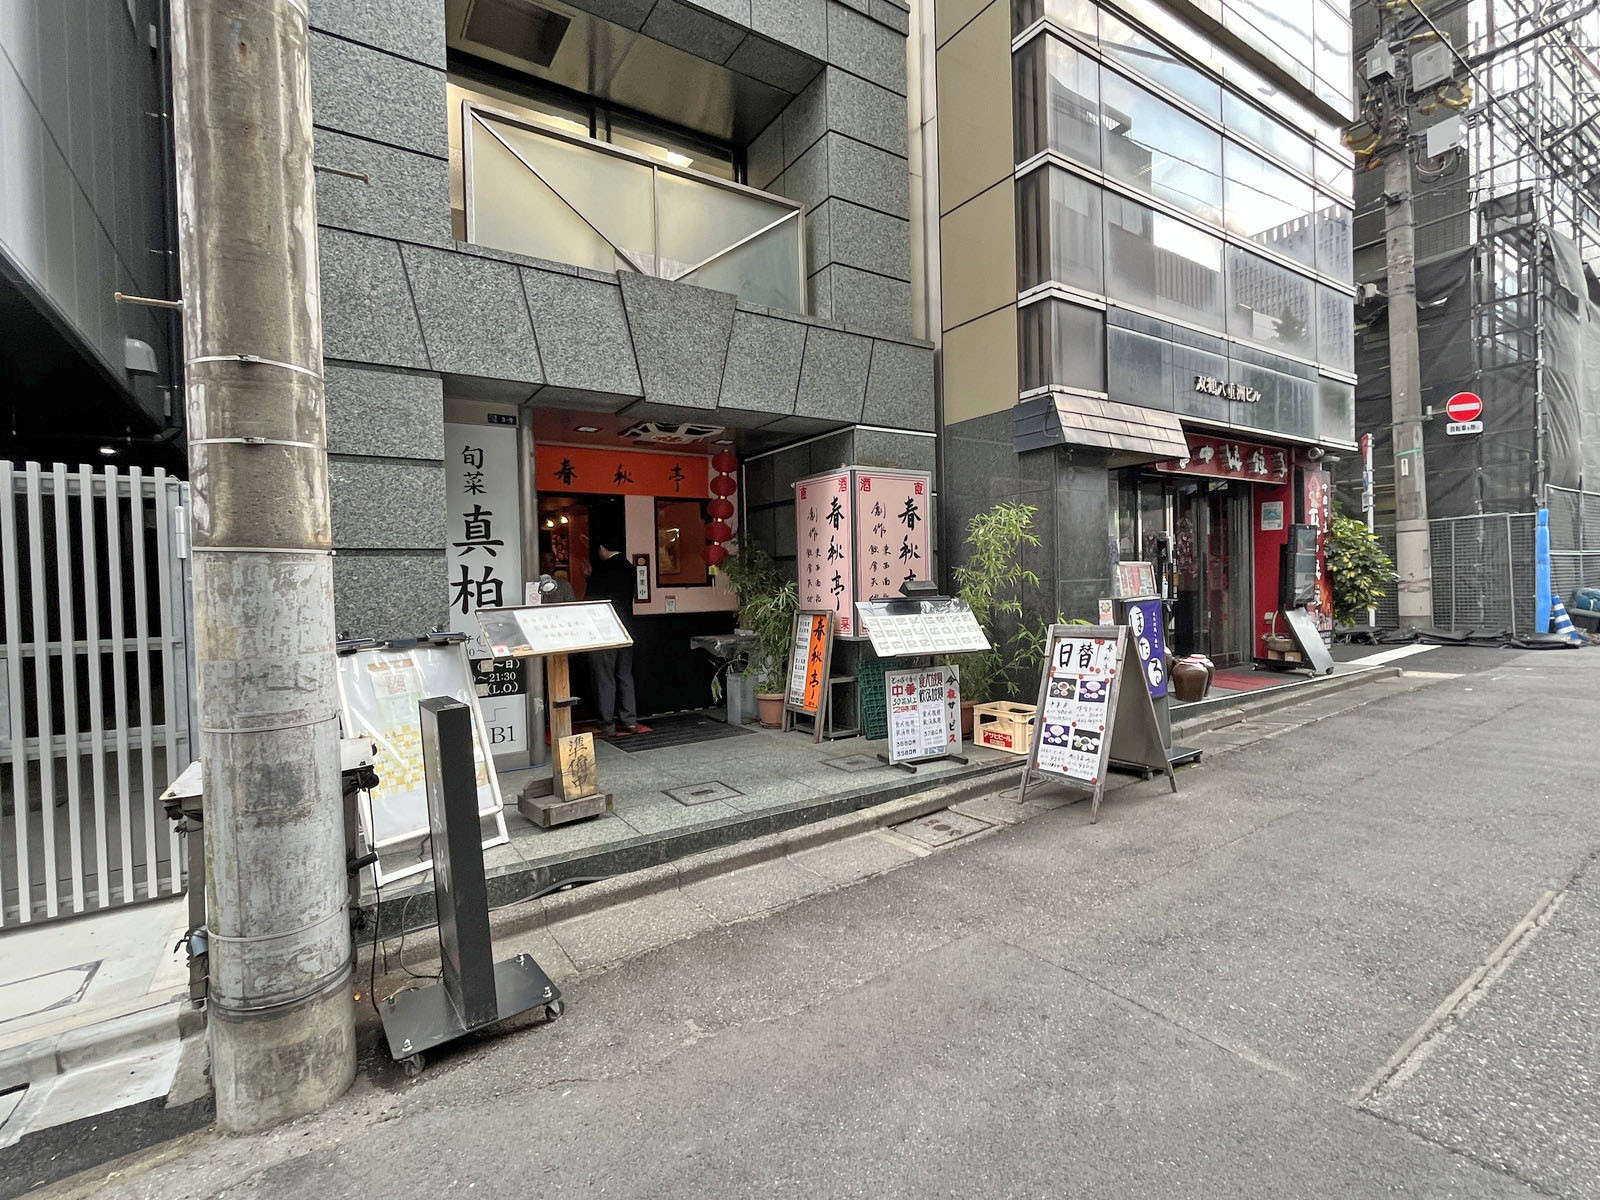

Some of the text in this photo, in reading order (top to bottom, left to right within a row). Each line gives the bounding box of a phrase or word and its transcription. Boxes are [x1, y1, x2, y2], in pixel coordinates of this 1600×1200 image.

[553, 457, 686, 493] 春秋亭
[860, 477, 871, 493] 酒
[450, 445, 505, 615] 旬菜 真柏
[826, 495, 845, 612] 春秋亭
[808, 617, 825, 700] 春秋亭
[1060, 641, 1094, 669] 日替
[1130, 610, 1162, 687] ほたる
[477, 659, 520, 673] (～日)
[891, 683, 917, 698] 中華
[489, 725, 516, 745] B1
